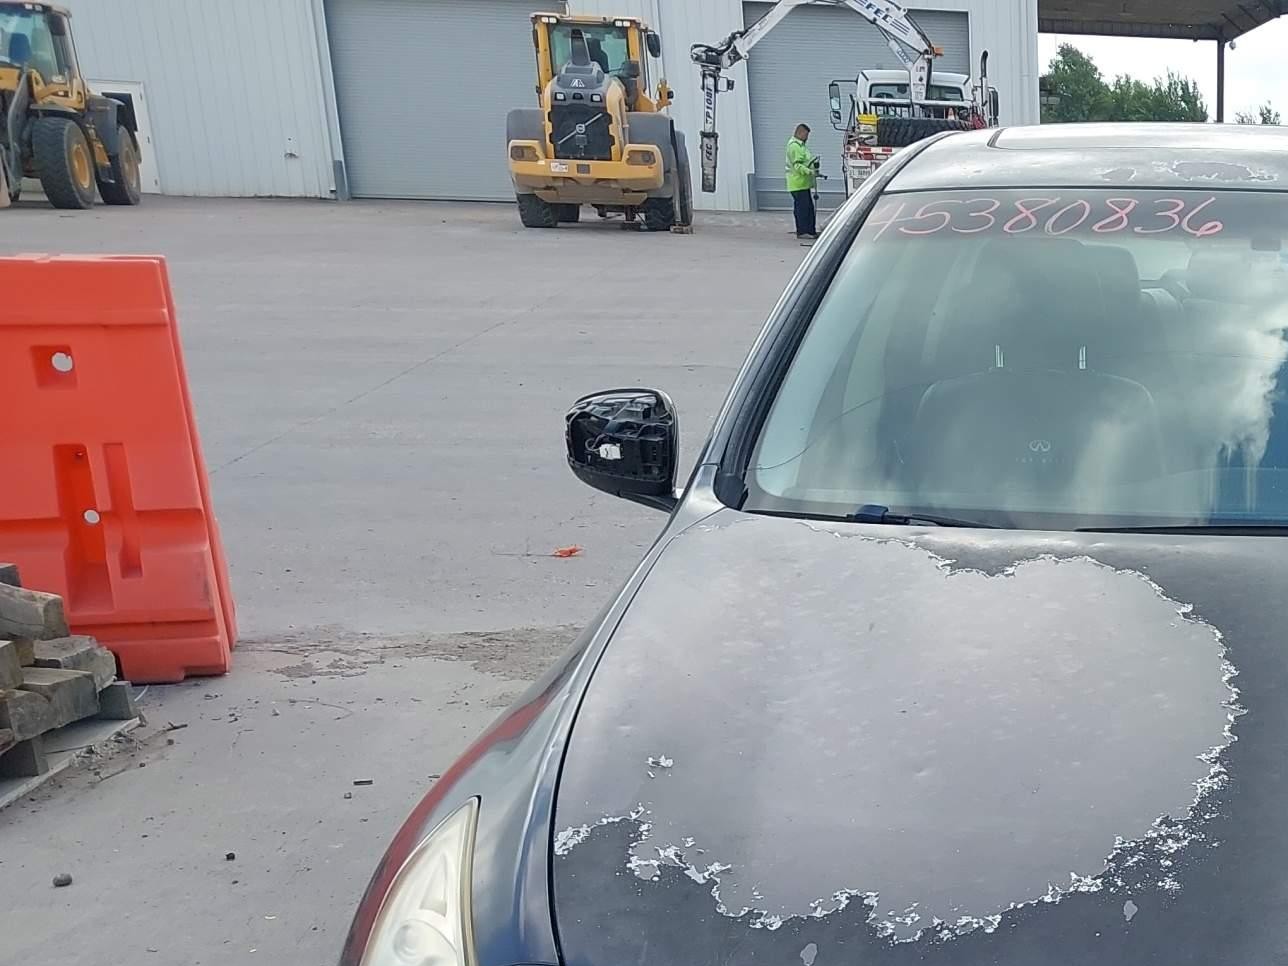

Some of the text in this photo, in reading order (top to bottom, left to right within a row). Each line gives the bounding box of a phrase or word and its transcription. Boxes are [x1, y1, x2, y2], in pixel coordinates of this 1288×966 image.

[864, 2, 893, 24] FEC
[704, 143, 713, 161] FEC
[866, 197, 1224, 242] 45380836
